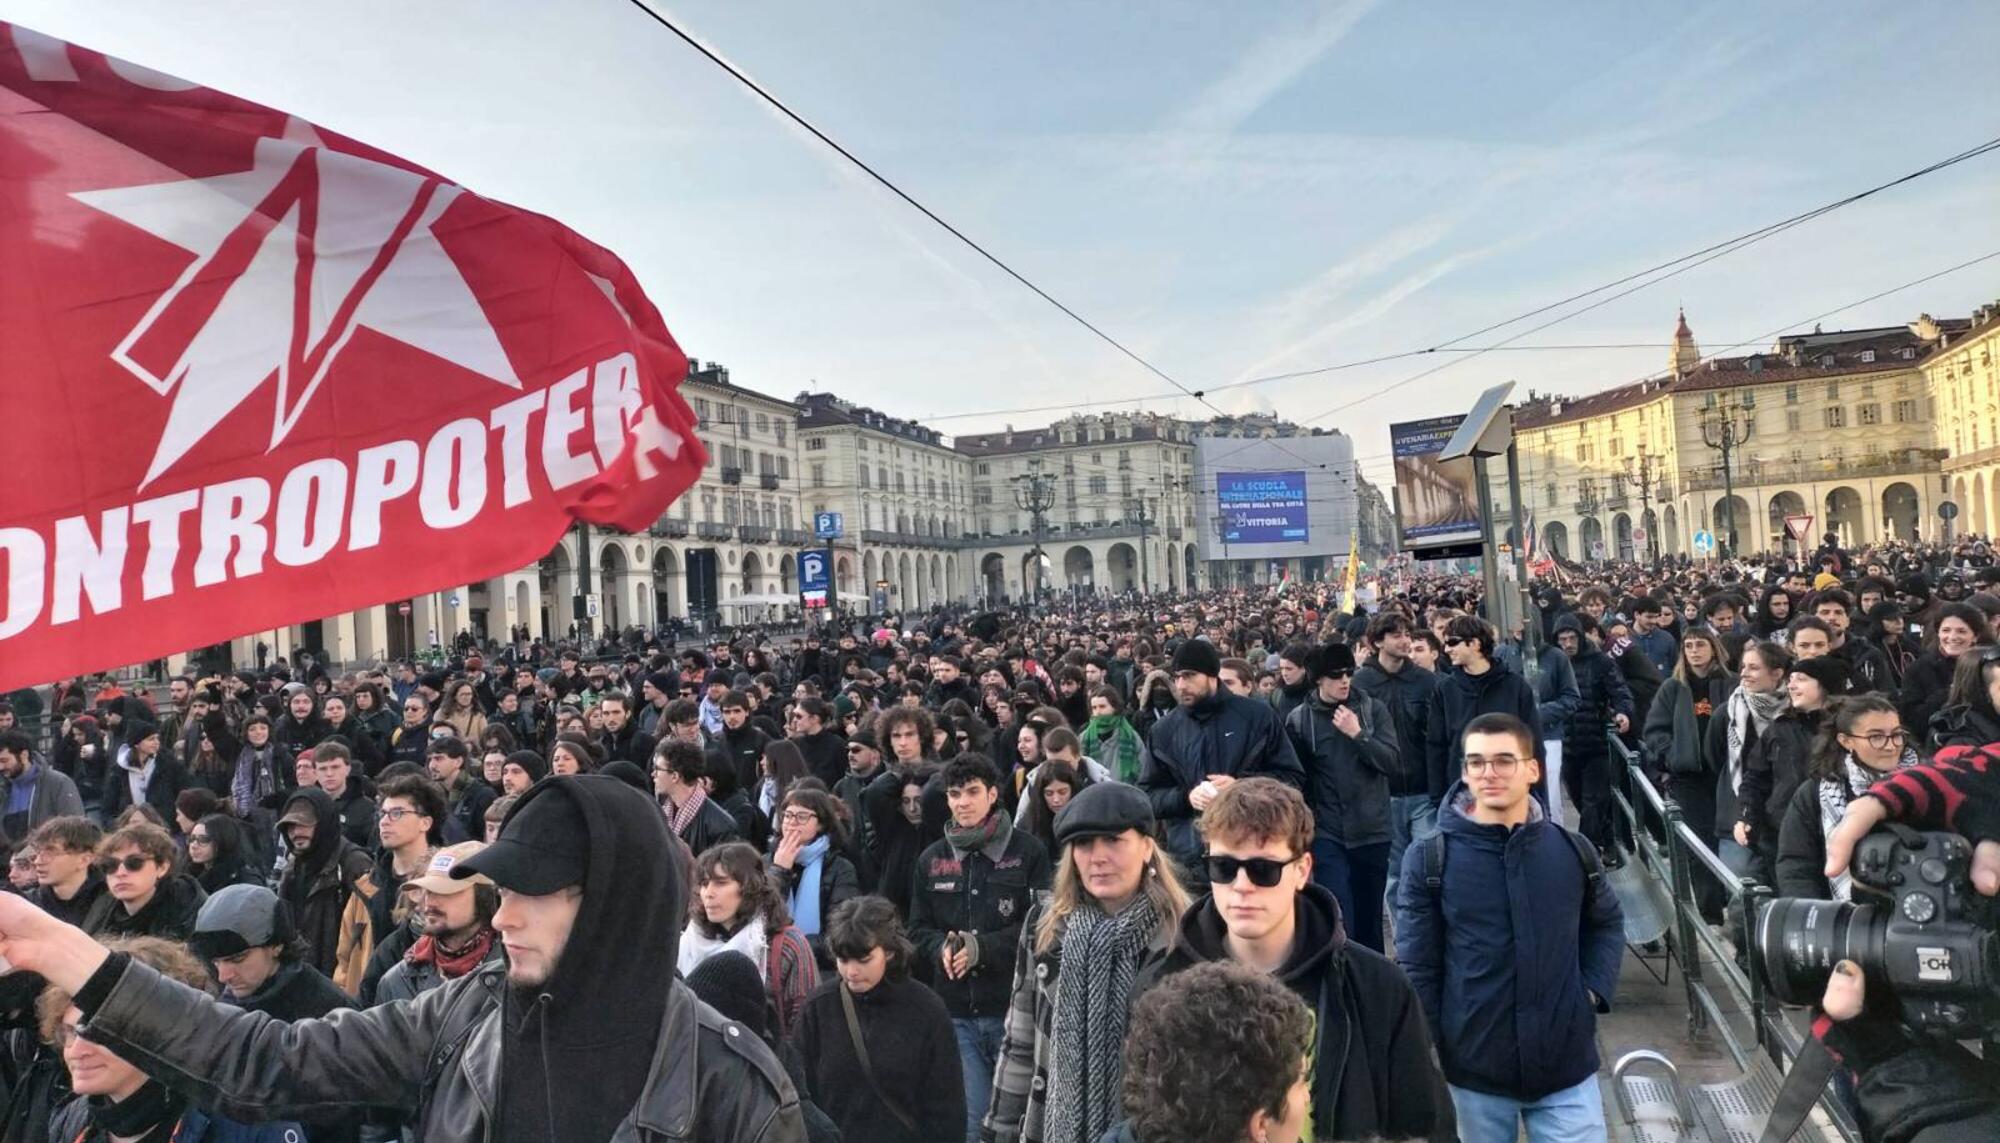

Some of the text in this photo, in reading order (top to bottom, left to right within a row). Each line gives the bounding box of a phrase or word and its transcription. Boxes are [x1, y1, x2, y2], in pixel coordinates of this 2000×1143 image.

[1247, 480, 1288, 491] SCUOLA
[819, 518, 831, 531] P
[1246, 517, 1288, 527] VITTORIA
[805, 560, 822, 582] P
